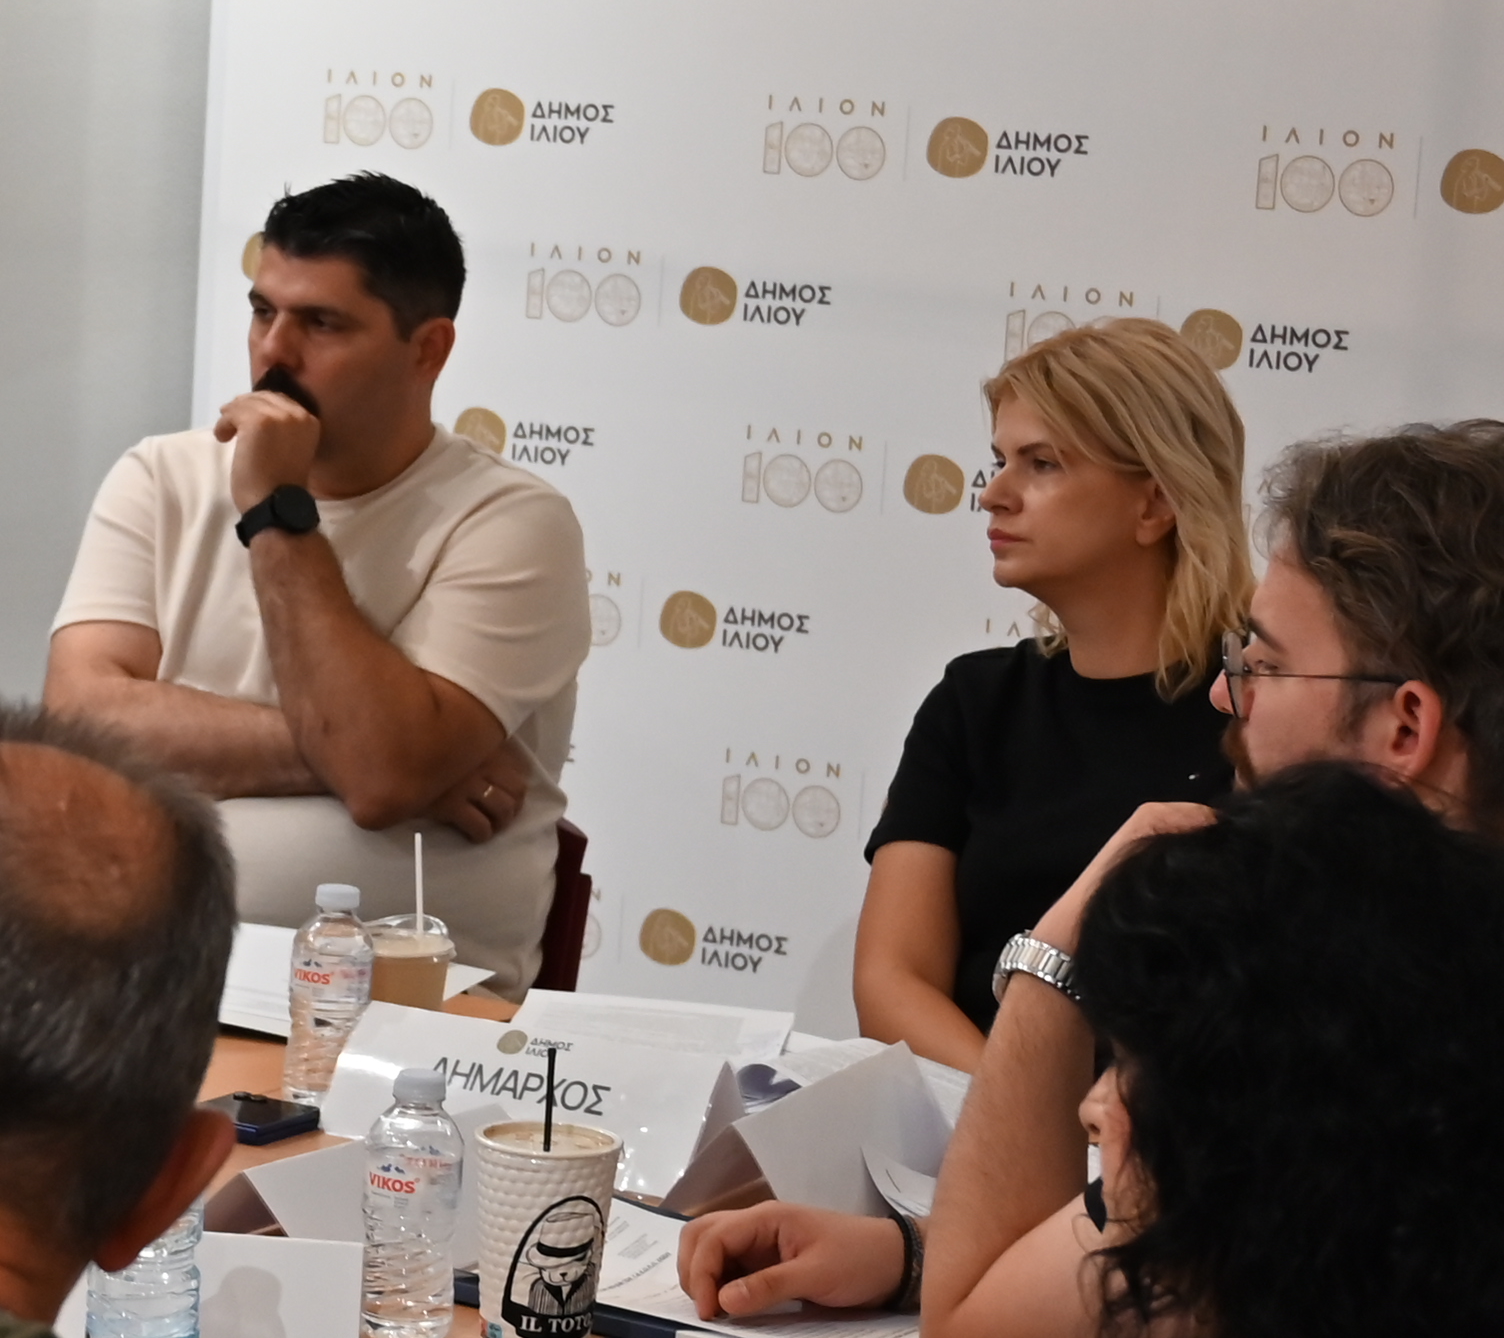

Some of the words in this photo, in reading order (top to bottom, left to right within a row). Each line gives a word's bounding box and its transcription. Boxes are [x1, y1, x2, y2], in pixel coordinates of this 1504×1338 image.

[327, 69, 433, 89] ΙΛΙΟΝ
[531, 101, 614, 123] ΔΗΜΟΣ
[768, 94, 886, 117] ΙΛΙΟΝ
[530, 124, 590, 144] ΙΛΙΟΥ
[996, 131, 1089, 155] ΔΗΜΟΣ
[1262, 125, 1395, 149] ΙΛΙΟΝ
[994, 155, 1061, 177] ΙΛΙΟΥ
[530, 242, 642, 266] ΙΛΙΟΝ
[744, 280, 831, 305] ΔΗΜΟΣ
[1009, 281, 1135, 307] ΙΛΙΟΝ
[743, 303, 806, 326] ΙΛΙΟΥ
[1250, 324, 1349, 351] ΔΗΜΟΣ
[1249, 348, 1319, 373] ΙΛΙΟΥ
[513, 422, 595, 446] ΔΗΜΟΣ
[746, 424, 864, 452] ΙΛΙΟΝ
[511, 443, 570, 467] ΙΛΙΟΥ
[723, 606, 810, 634] ΔΗΜΟΣ
[722, 629, 784, 653] ΙΛΙΟΥ
[725, 748, 842, 779] ΙΛΙΟΝ
[702, 926, 788, 956] ΔΗΜΟΣ
[701, 947, 762, 973] ΙΛΙΟΥ
[525, 1046, 550, 1058] ΙΛΙΟ
[369, 1171, 416, 1194] VIKOS
[519, 1314, 542, 1333] IL
